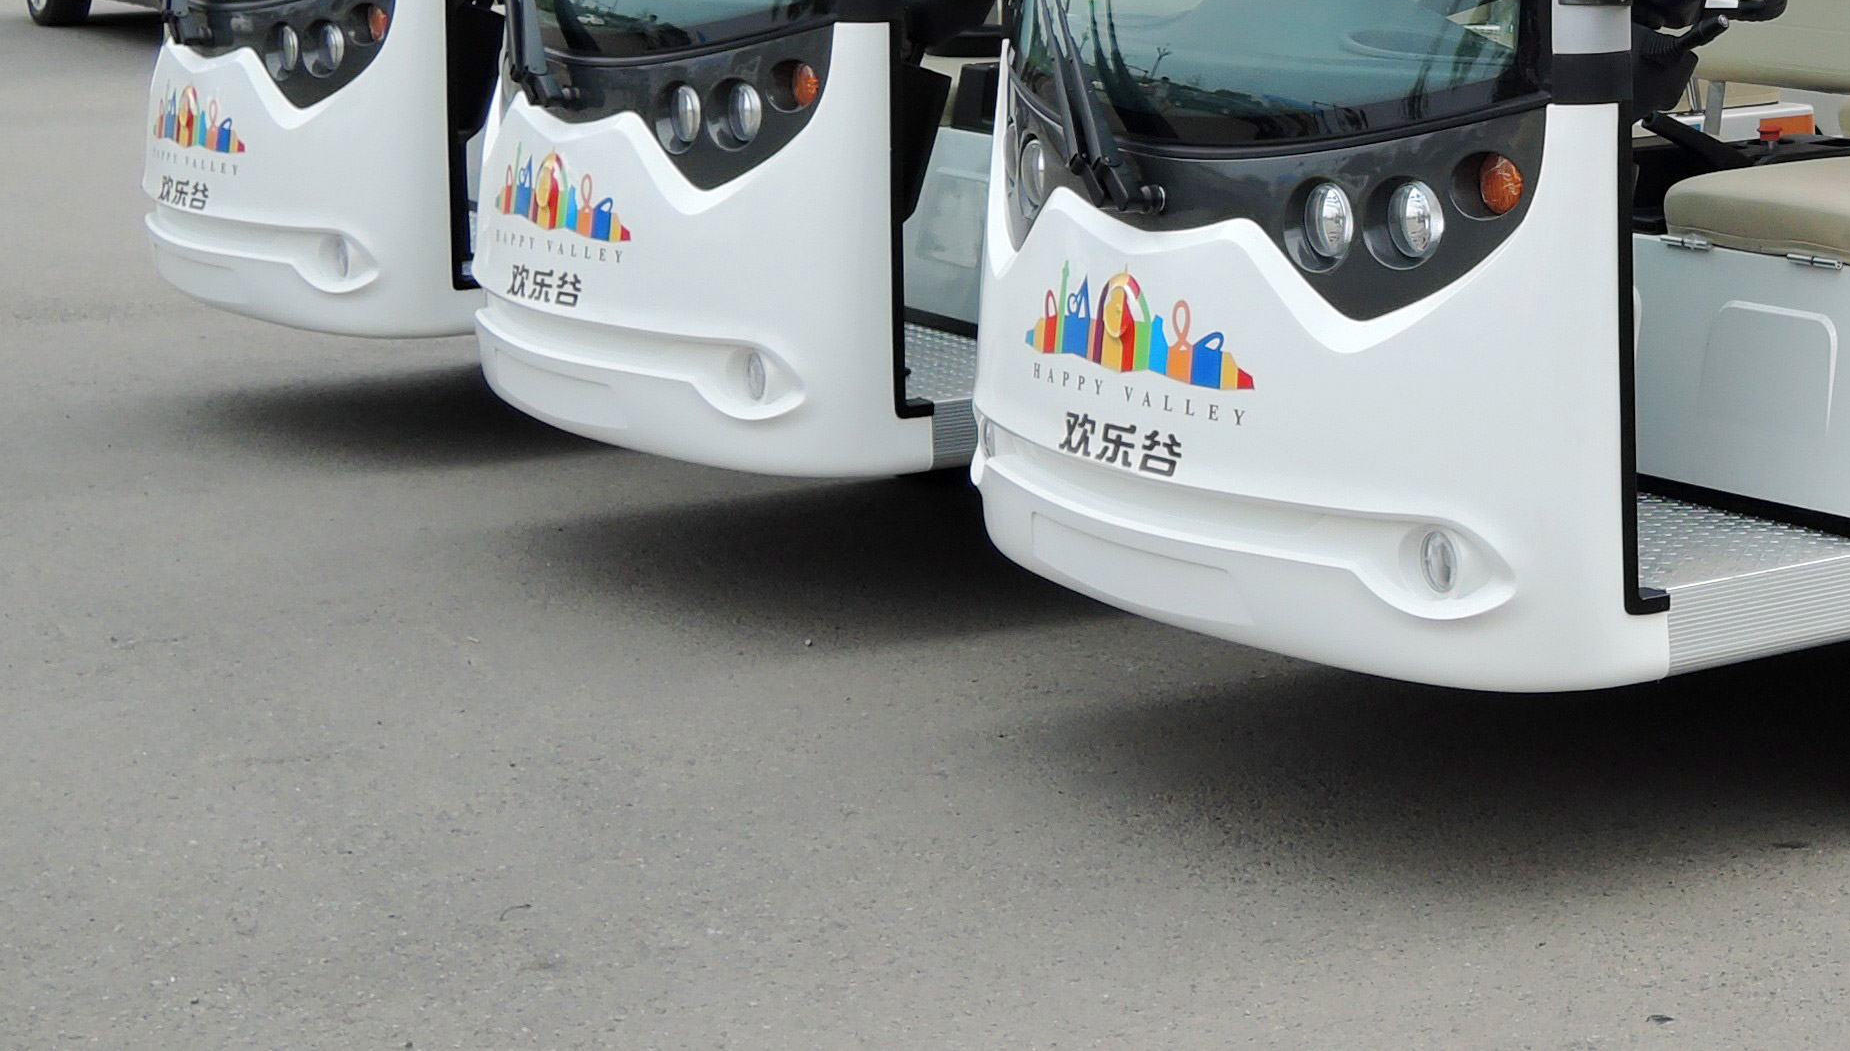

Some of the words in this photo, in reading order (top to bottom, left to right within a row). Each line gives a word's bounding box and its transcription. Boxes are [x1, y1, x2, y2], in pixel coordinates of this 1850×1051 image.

[185, 156, 238, 176] VALLEY
[158, 175, 209, 211] 欢乐谷
[496, 229, 535, 250] HAPPY
[547, 240, 623, 263] VALLEY
[506, 264, 582, 307] 欢乐谷
[1033, 361, 1104, 396] HAPPY
[1124, 386, 1246, 426] VALLEY
[1058, 411, 1182, 478] 欢乐谷
